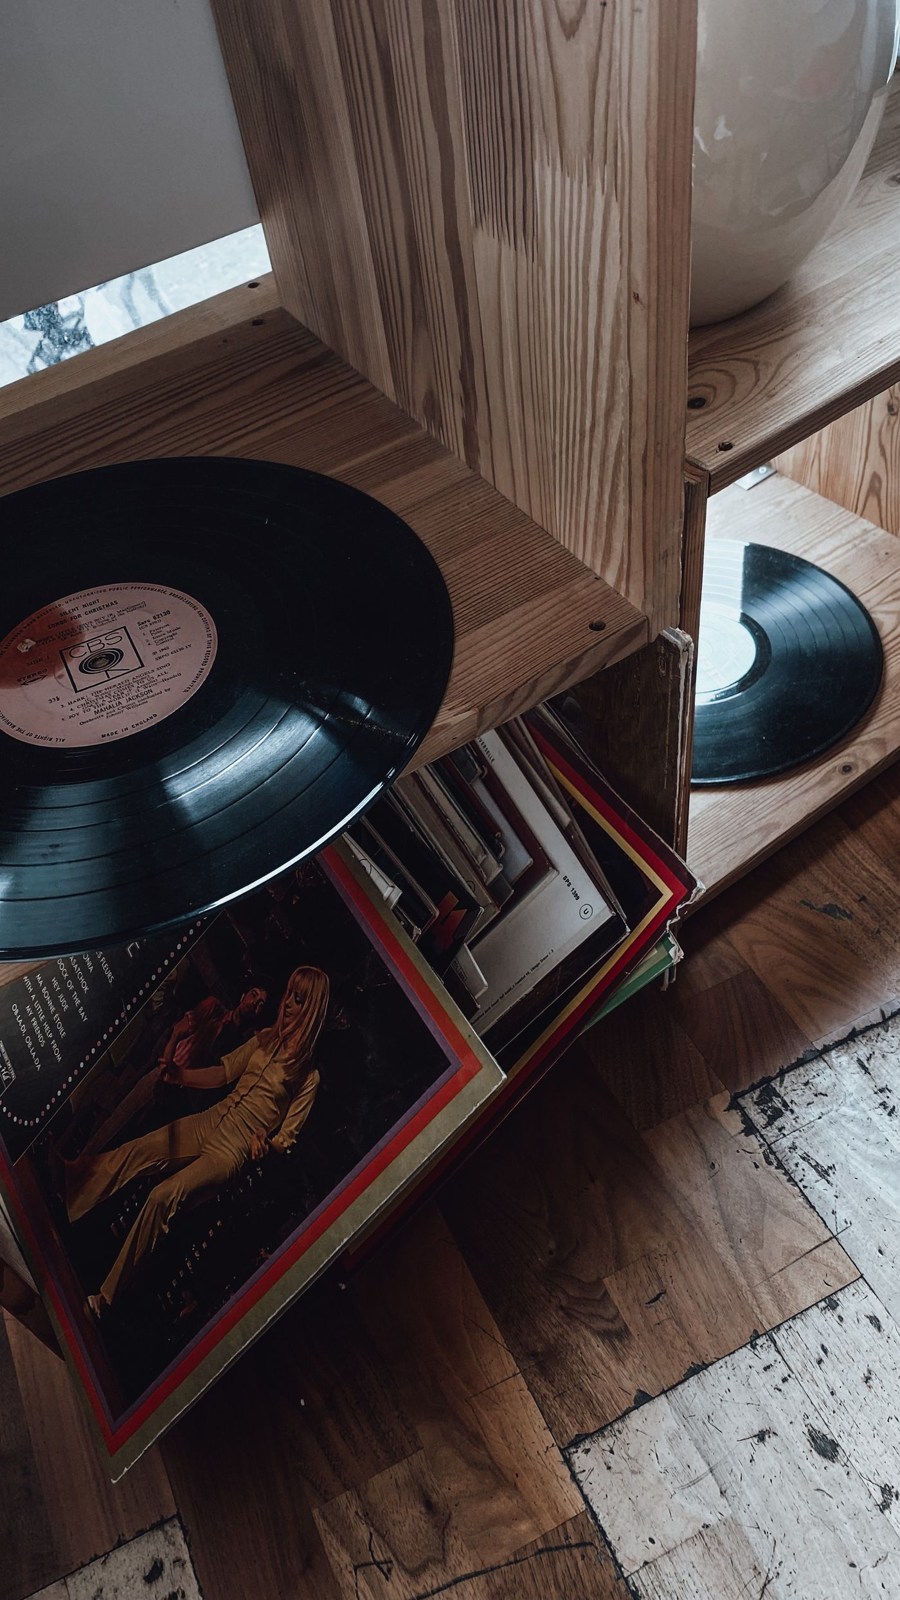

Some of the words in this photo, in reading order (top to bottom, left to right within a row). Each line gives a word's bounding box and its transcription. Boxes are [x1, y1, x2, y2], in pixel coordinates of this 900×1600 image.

[60, 607, 79, 616] SILENT
[82, 599, 100, 608] NIGHT
[85, 601, 118, 615] CHRISTMAS
[69, 632, 122, 658] CBS
[94, 701, 123, 714] MAHALIA
[125, 689, 153, 703] JACKSON
[132, 714, 158, 728] ENGLAND
[69, 956, 89, 994] ASATCHOK
[99, 958, 115, 984] FLEURS
[35, 973, 43, 985] MA
[41, 986, 56, 1014] BONNE
[51, 976, 60, 992] HEY
[58, 994, 69, 1012] JUDE
[56, 958, 69, 980] DOCK
[66, 980, 75, 991] OF
[71, 992, 80, 1007] THE
[79, 1006, 88, 1022] BAY
[22, 976, 33, 994] WITH
[33, 1001, 45, 1022] LITTLE
[42, 1021, 53, 1039] HELP
[50, 1039, 62, 1063] FROM
[25, 1005, 33, 1017] MY
[30, 1016, 46, 1048] FRIENDS
